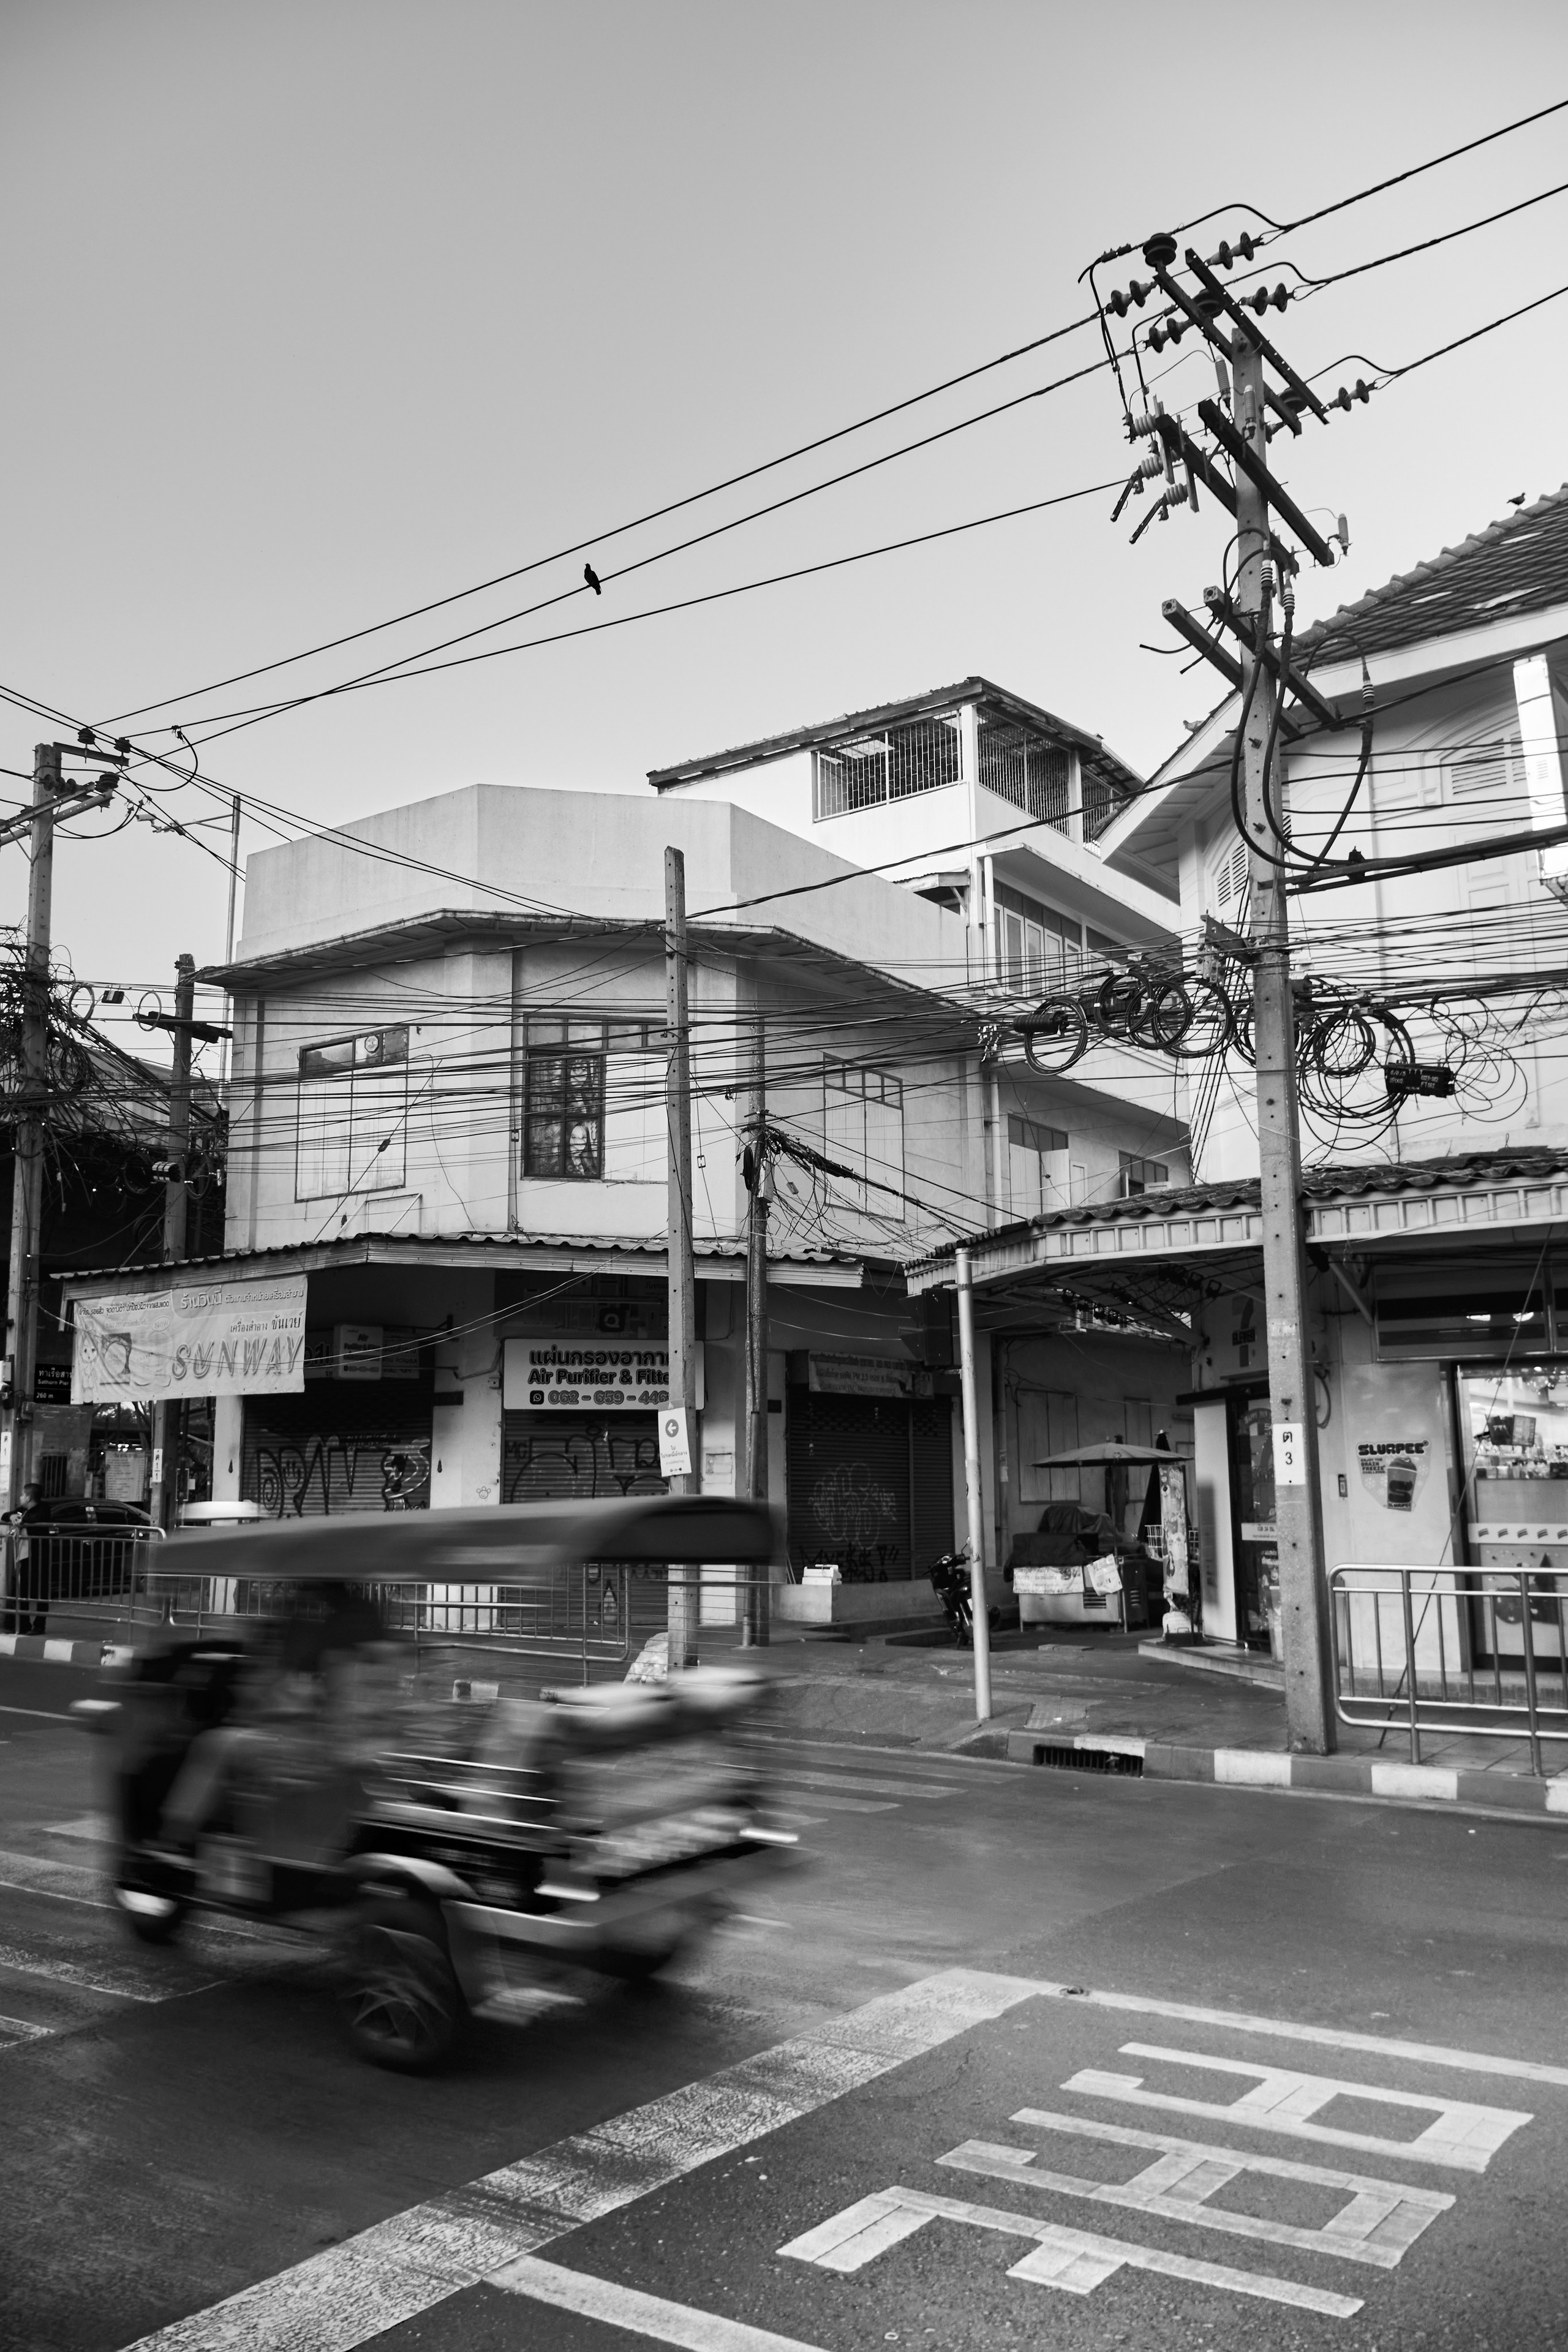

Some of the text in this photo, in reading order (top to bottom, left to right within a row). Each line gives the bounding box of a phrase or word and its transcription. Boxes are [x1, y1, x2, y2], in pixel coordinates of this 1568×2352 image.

[172, 1334, 304, 1380] SUNWAY
[527, 1368, 669, 1385] Air Purifier & Filte
[548, 1390, 579, 1404] 062
[593, 1390, 624, 1404] 659
[638, 1390, 669, 1404] 446
[1283, 1431, 1292, 1442] ต
[1285, 1452, 1292, 1465] 3
